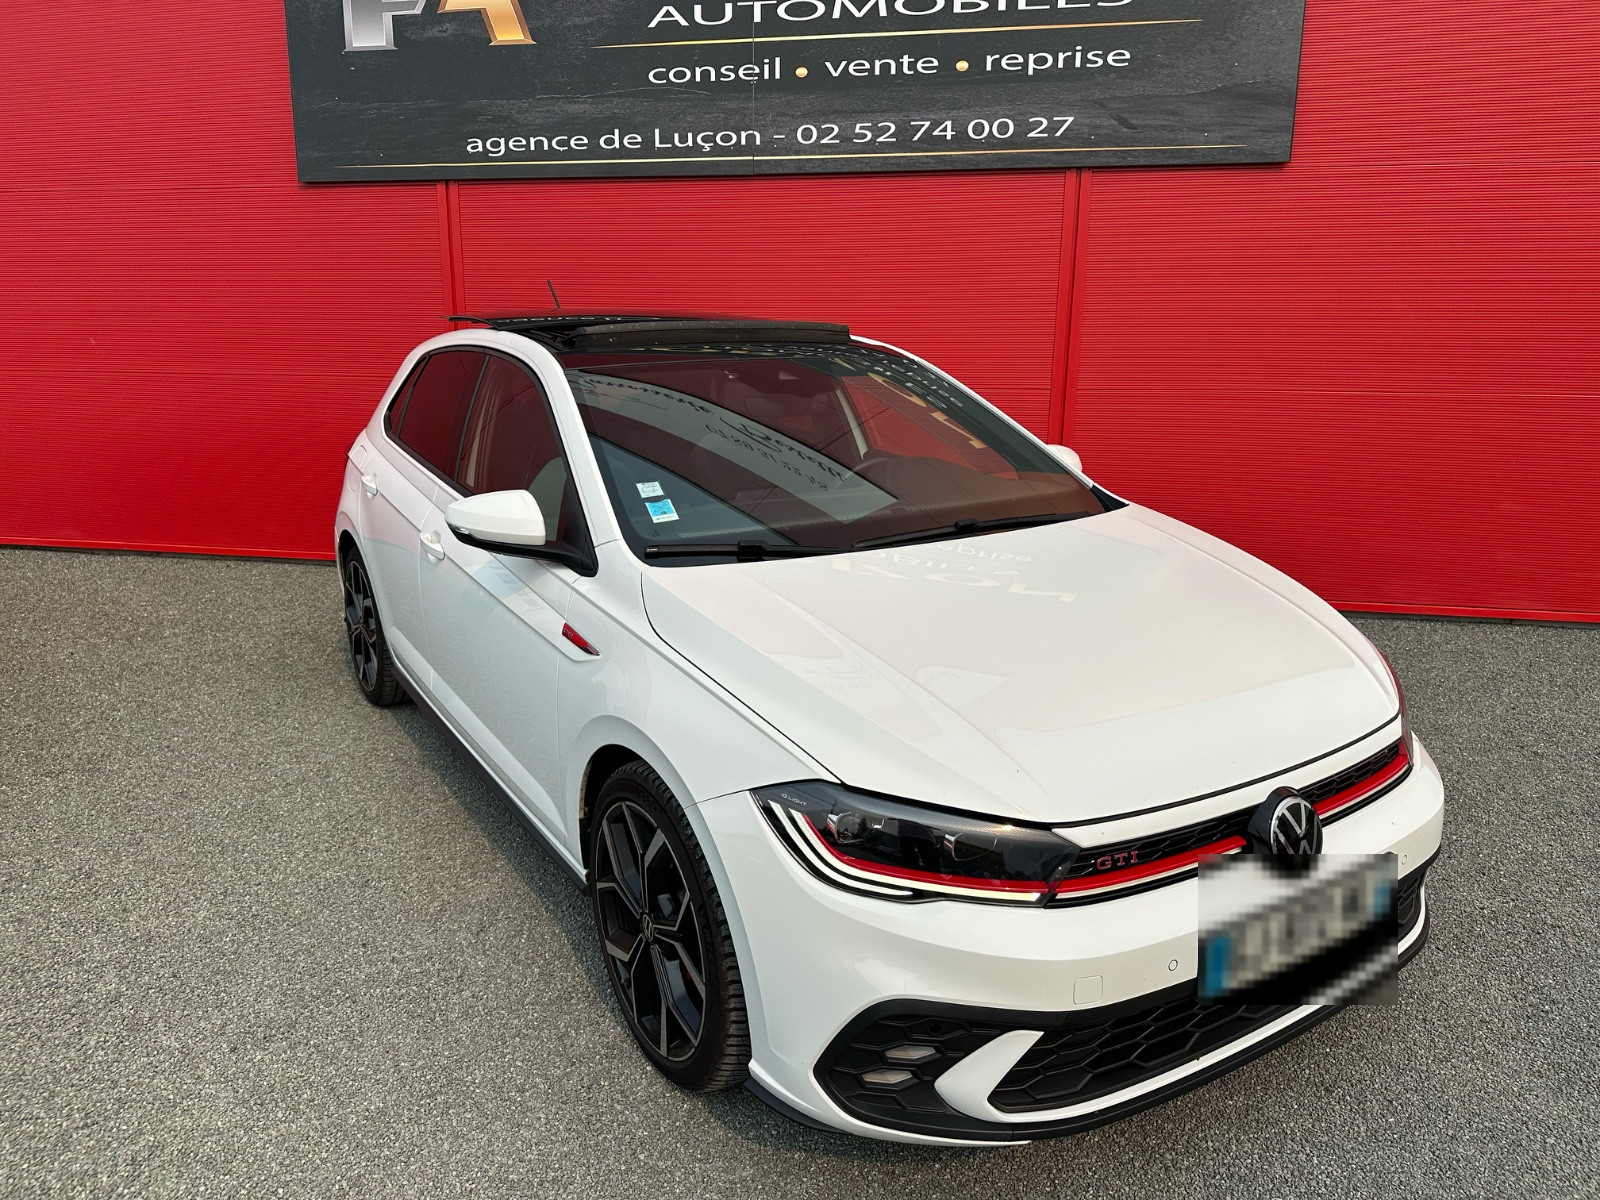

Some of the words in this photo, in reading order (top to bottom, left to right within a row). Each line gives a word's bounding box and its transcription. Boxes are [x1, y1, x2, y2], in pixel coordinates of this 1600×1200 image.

[647, 0, 1134, 28] AUTOMOBIL
[648, 57, 781, 84] conseil
[824, 54, 939, 77] vente
[985, 45, 1131, 76] reprise
[466, 133, 589, 157] agence
[599, 128, 643, 150] de
[654, 128, 761, 152] Luçon
[796, 123, 840, 145] 02
[852, 121, 897, 143] 52
[910, 120, 956, 141] 74
[967, 117, 1015, 140] 00
[1026, 116, 1075, 138] 27
[1096, 850, 1139, 870] GTI
